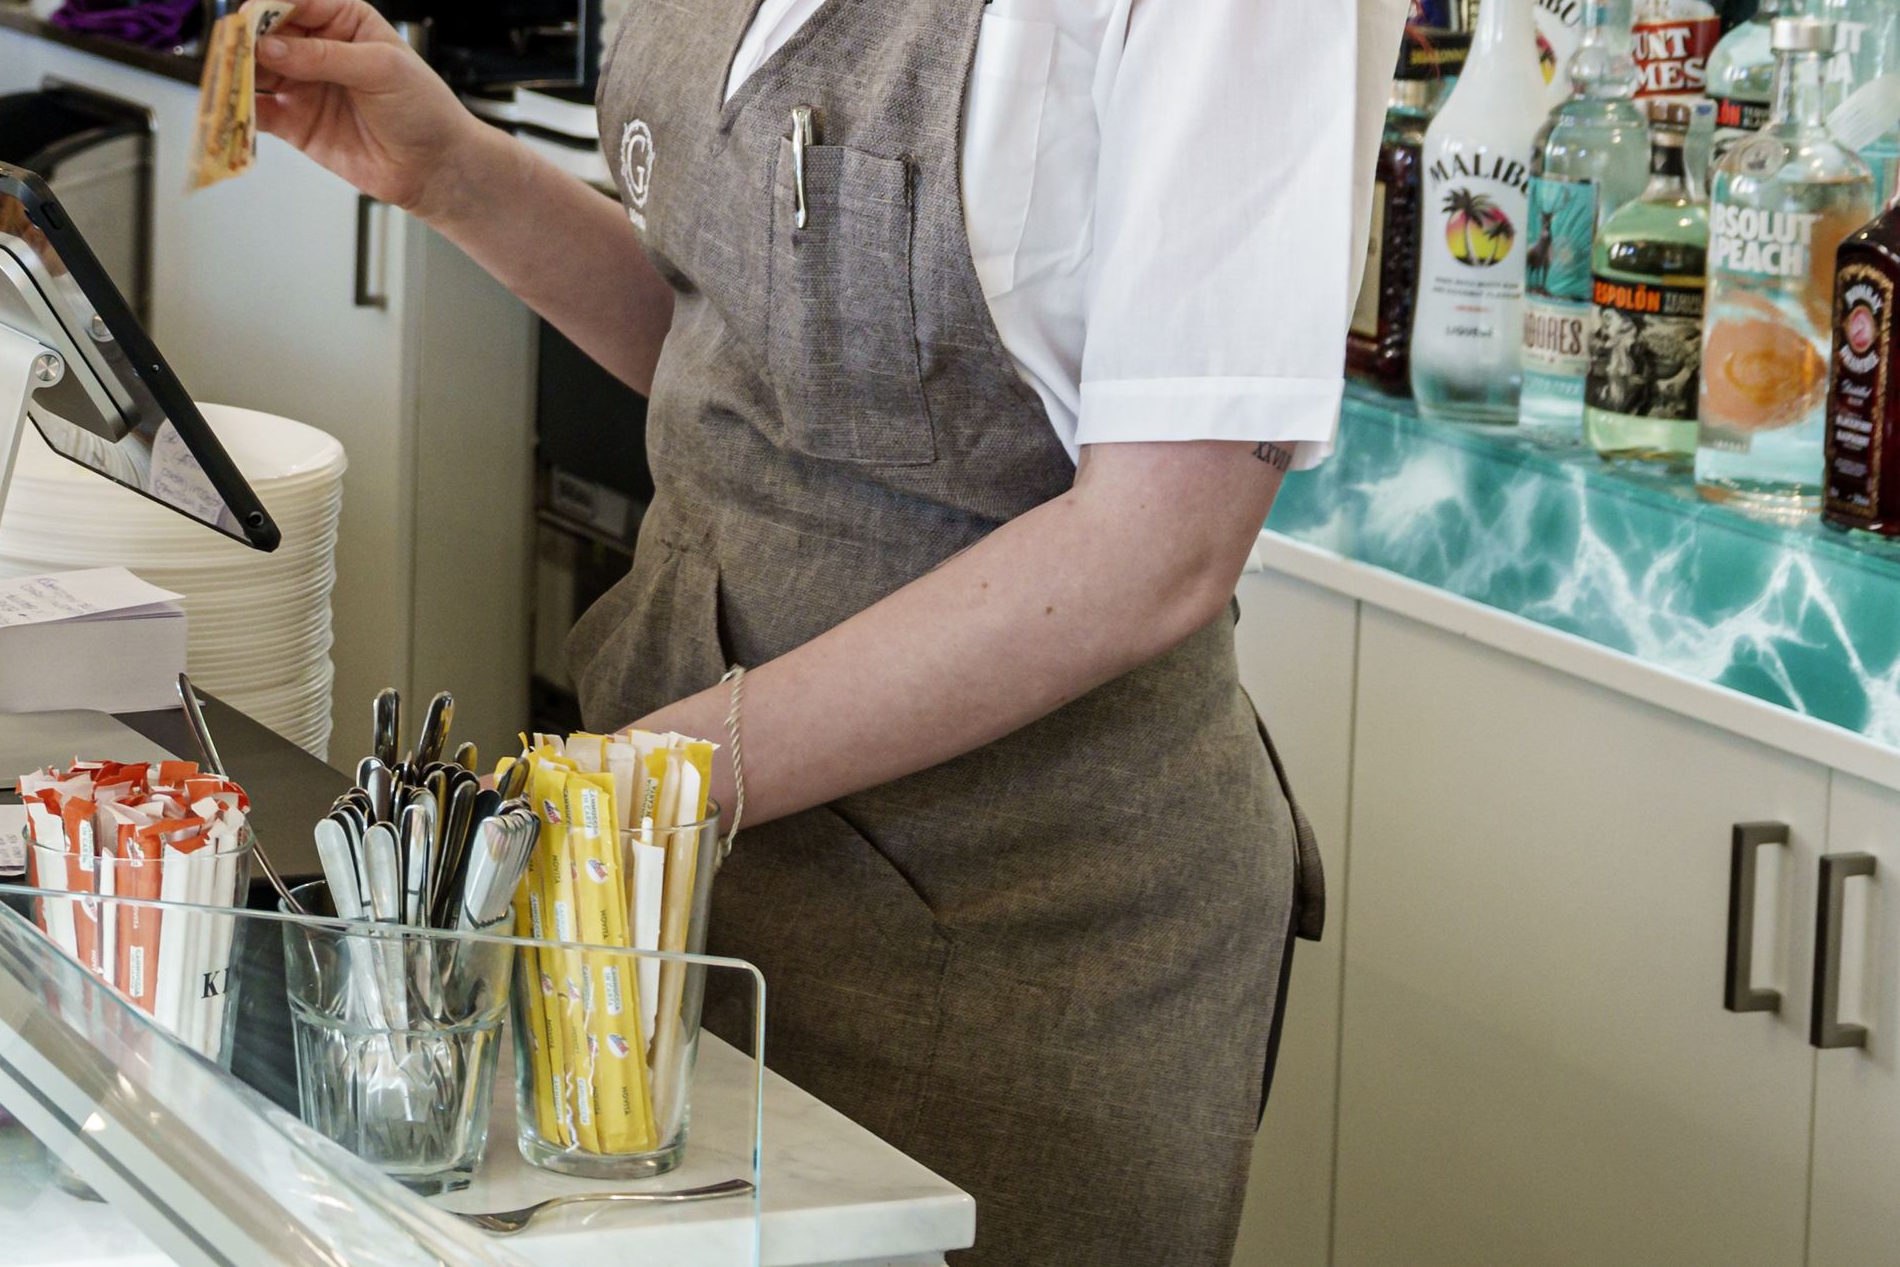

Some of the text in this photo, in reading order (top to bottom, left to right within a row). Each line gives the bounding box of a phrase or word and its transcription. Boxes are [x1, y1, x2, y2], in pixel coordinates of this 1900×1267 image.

[1635, 27, 1691, 60] UNT
[627, 134, 646, 194] G
[1429, 153, 1529, 199] MALIB
[1717, 237, 1806, 277] PEACH
[1594, 281, 1661, 313] ESPOLÓN
[600, 909, 609, 940] NOVITÀ
[605, 982, 614, 1006] CARTA
[610, 965, 620, 1011] CANNUCCIA
[622, 1086, 631, 1116] NOVITÀ
